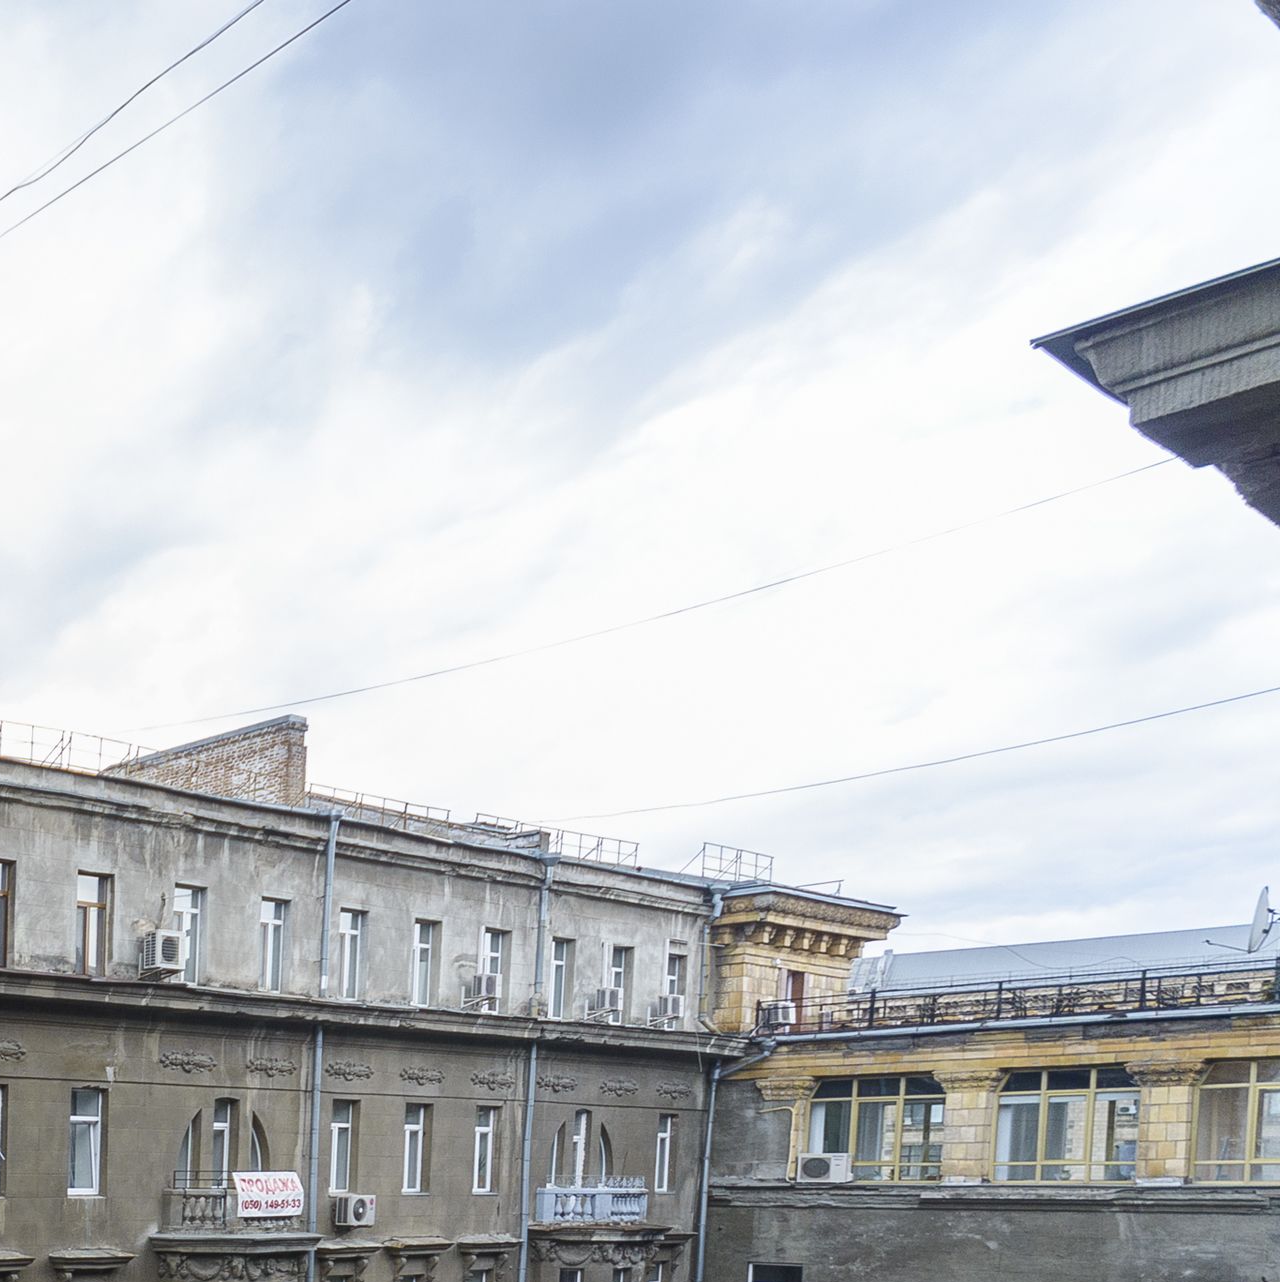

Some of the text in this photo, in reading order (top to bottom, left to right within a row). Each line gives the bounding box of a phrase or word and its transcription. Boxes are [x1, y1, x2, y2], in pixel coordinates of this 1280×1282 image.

[240, 1178, 300, 1194] ПРОДАЖА
[242, 1199, 301, 1211] (050) 149-51-33
